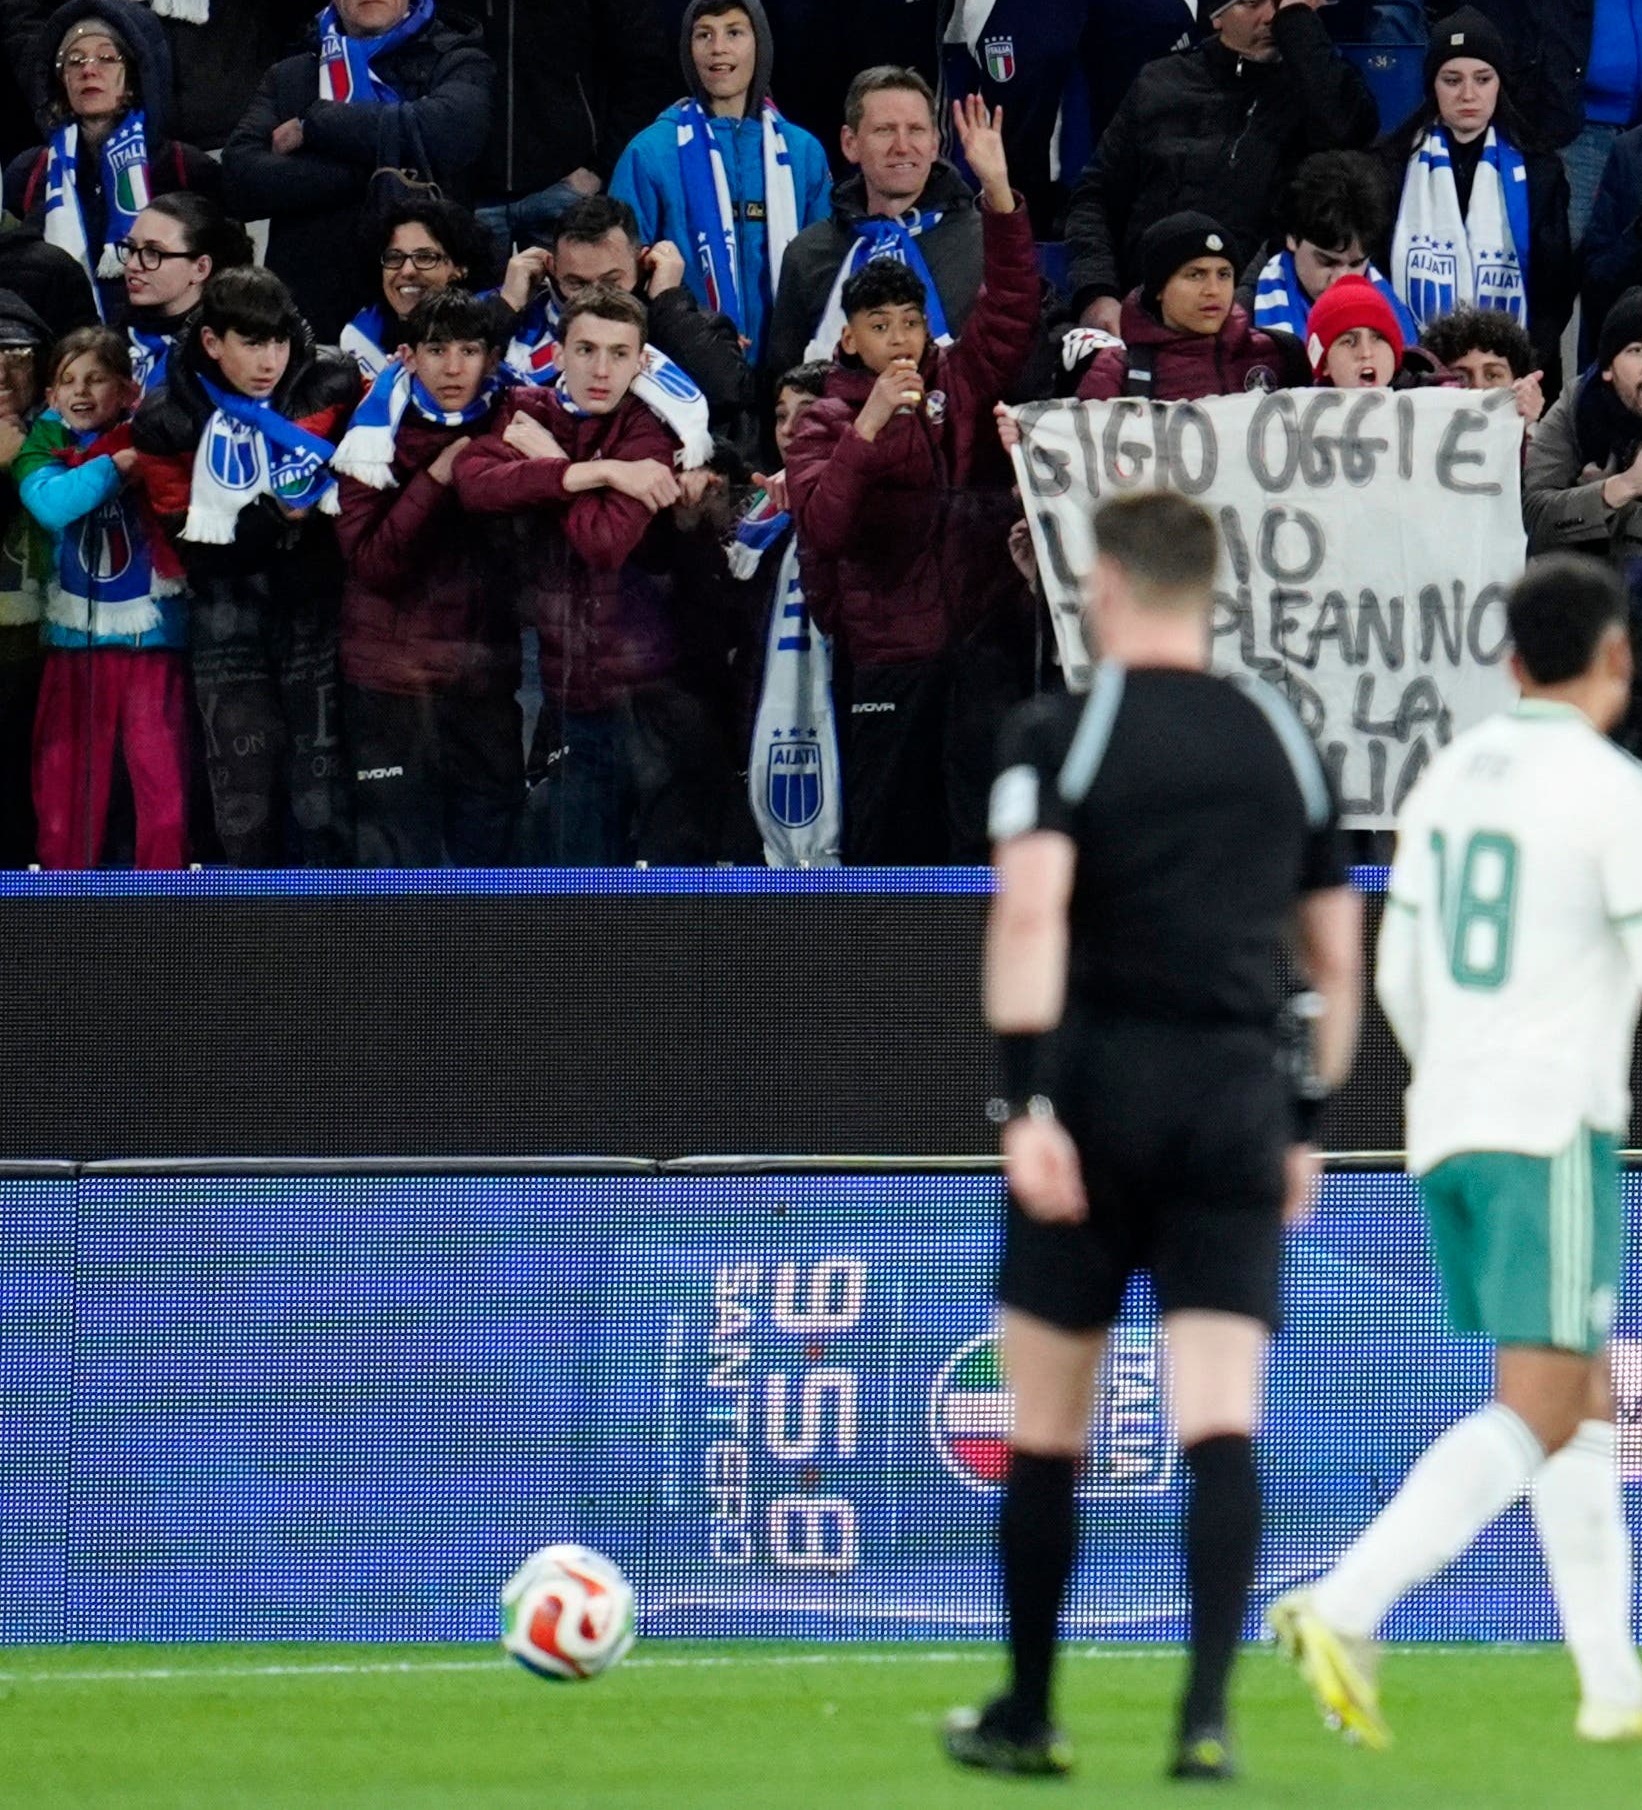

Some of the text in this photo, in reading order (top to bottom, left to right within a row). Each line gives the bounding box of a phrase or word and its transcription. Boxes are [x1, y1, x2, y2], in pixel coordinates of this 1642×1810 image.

[1000, 395, 1200, 500] GIGIO
[1247, 389, 1415, 494] OGGI
[1205, 582, 1512, 674] PLEANNO
[1430, 826, 1520, 994] 18
[705, 1258, 760, 1564] SANTERO
